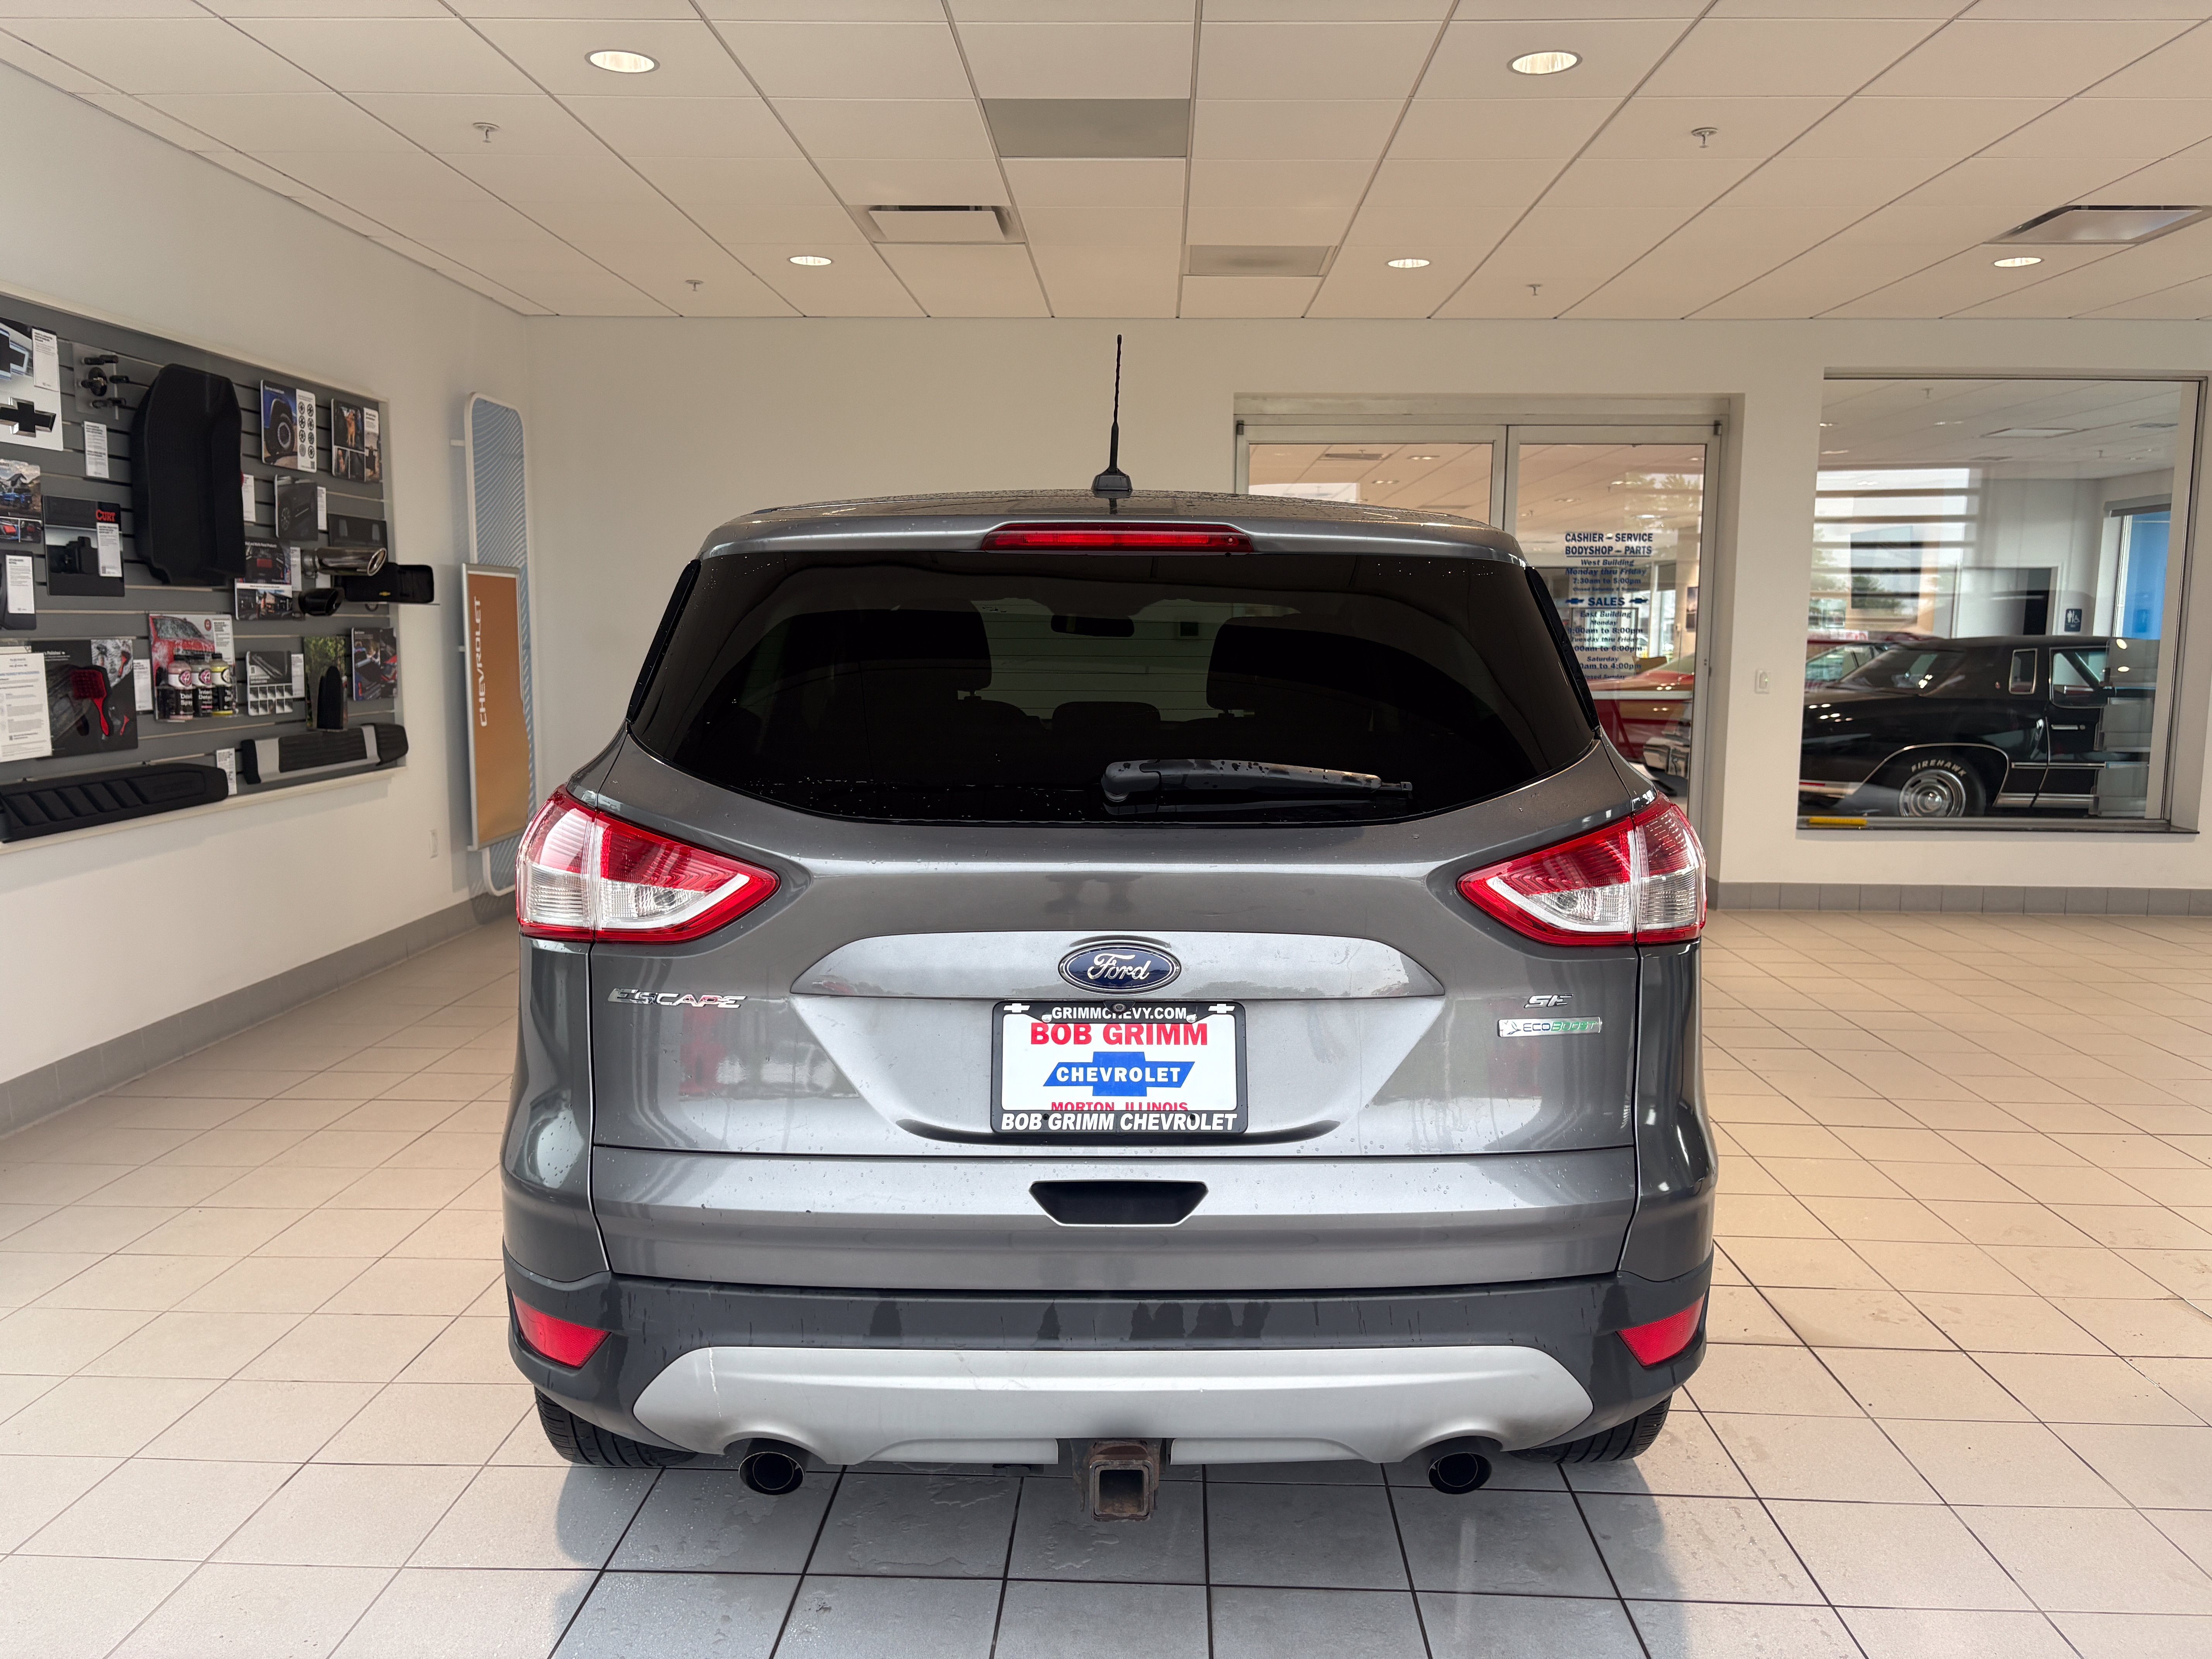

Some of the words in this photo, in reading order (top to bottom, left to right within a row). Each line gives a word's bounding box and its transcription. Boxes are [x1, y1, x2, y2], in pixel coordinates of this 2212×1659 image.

[1565, 533, 1604, 542] CASHIER
[1615, 533, 1653, 542] SERVICE
[1565, 546, 1613, 555] BODYSHOP
[1625, 546, 1652, 555] PARTS
[1566, 568, 1598, 576] Monday
[1620, 568, 1646, 576] Friday
[1588, 597, 1625, 606] SALES
[474, 596, 487, 727] CHEVROLET
[1911, 759, 1966, 777] FIREHAWK
[1087, 953, 1151, 980] Ford
[608, 988, 747, 1008] ESCAPE
[1523, 993, 1574, 1008] SE
[1030, 1023, 1092, 1045] BOB
[1103, 1023, 1207, 1045] GRIMM
[1056, 1066, 1181, 1082] CHEVROLET
[1001, 1113, 1046, 1130] BOB
[1048, 1113, 1115, 1131] GRIMM
[1120, 1113, 1237, 1131] CHEVROLET
